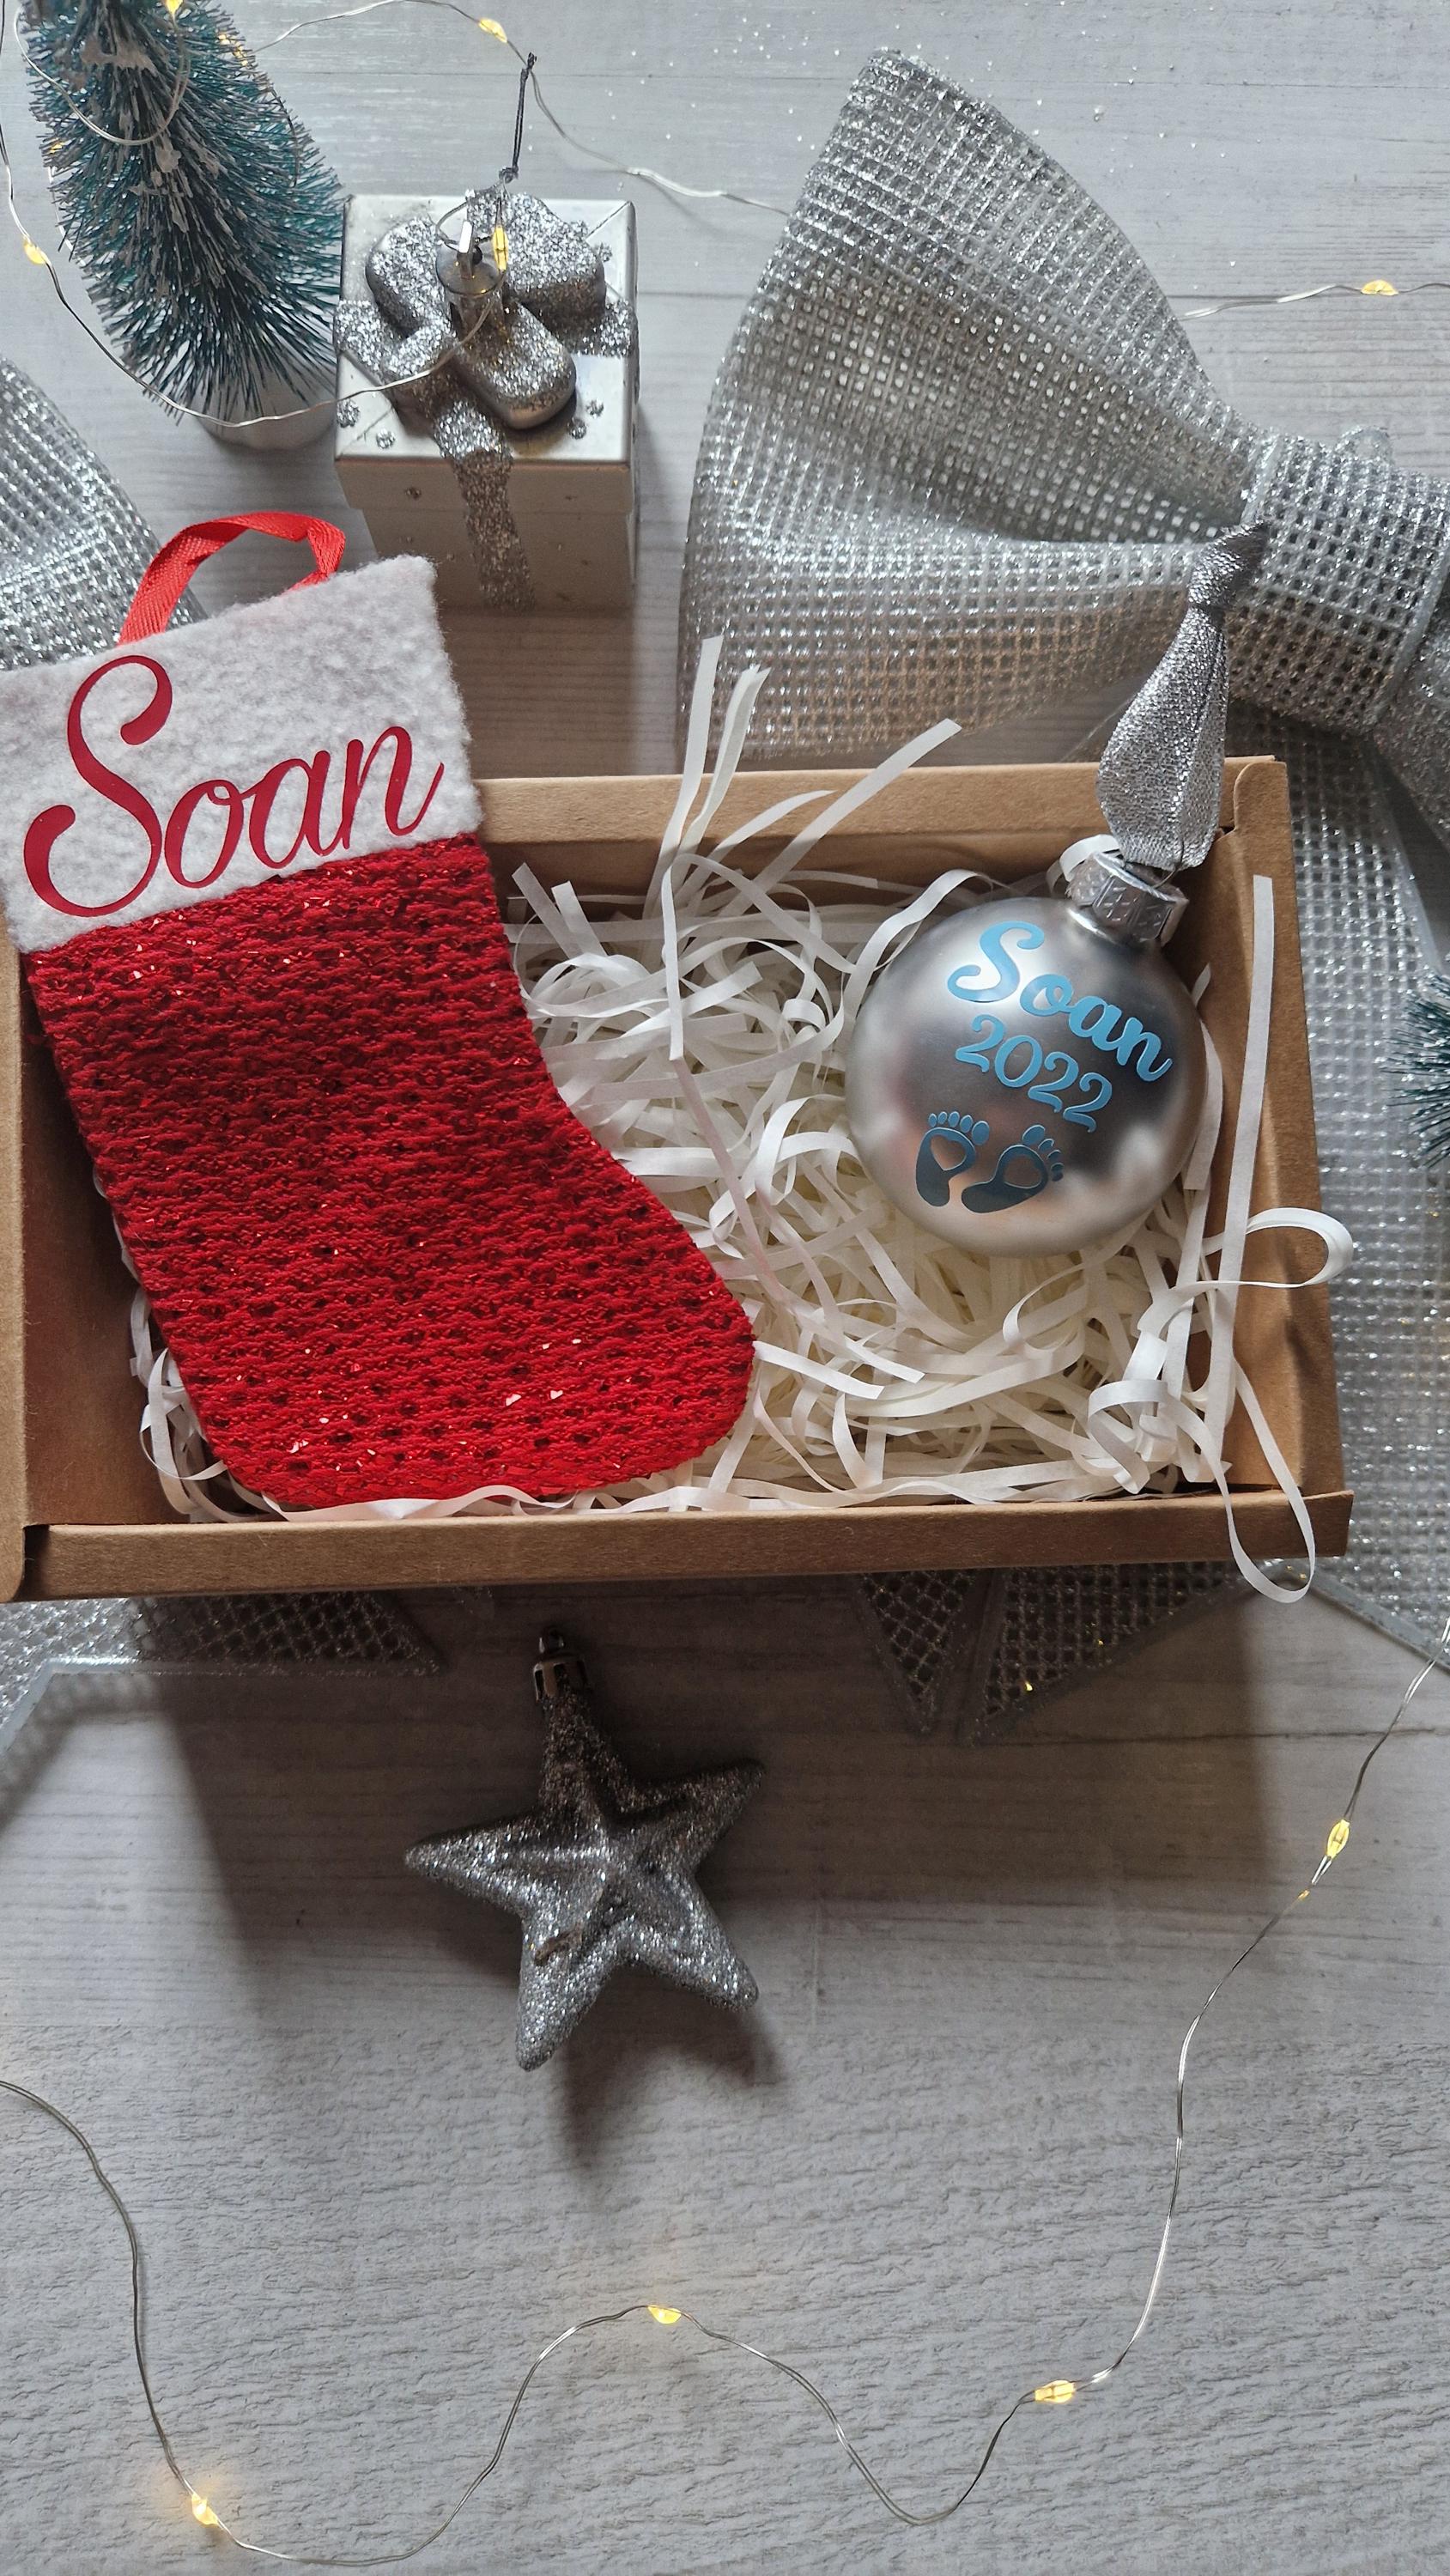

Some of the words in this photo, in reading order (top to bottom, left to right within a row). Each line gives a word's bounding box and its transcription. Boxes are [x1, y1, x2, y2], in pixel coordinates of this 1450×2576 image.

[23, 654, 445, 917] Soan
[946, 920, 1173, 1081] Soan
[955, 1013, 1113, 1133] 2022
